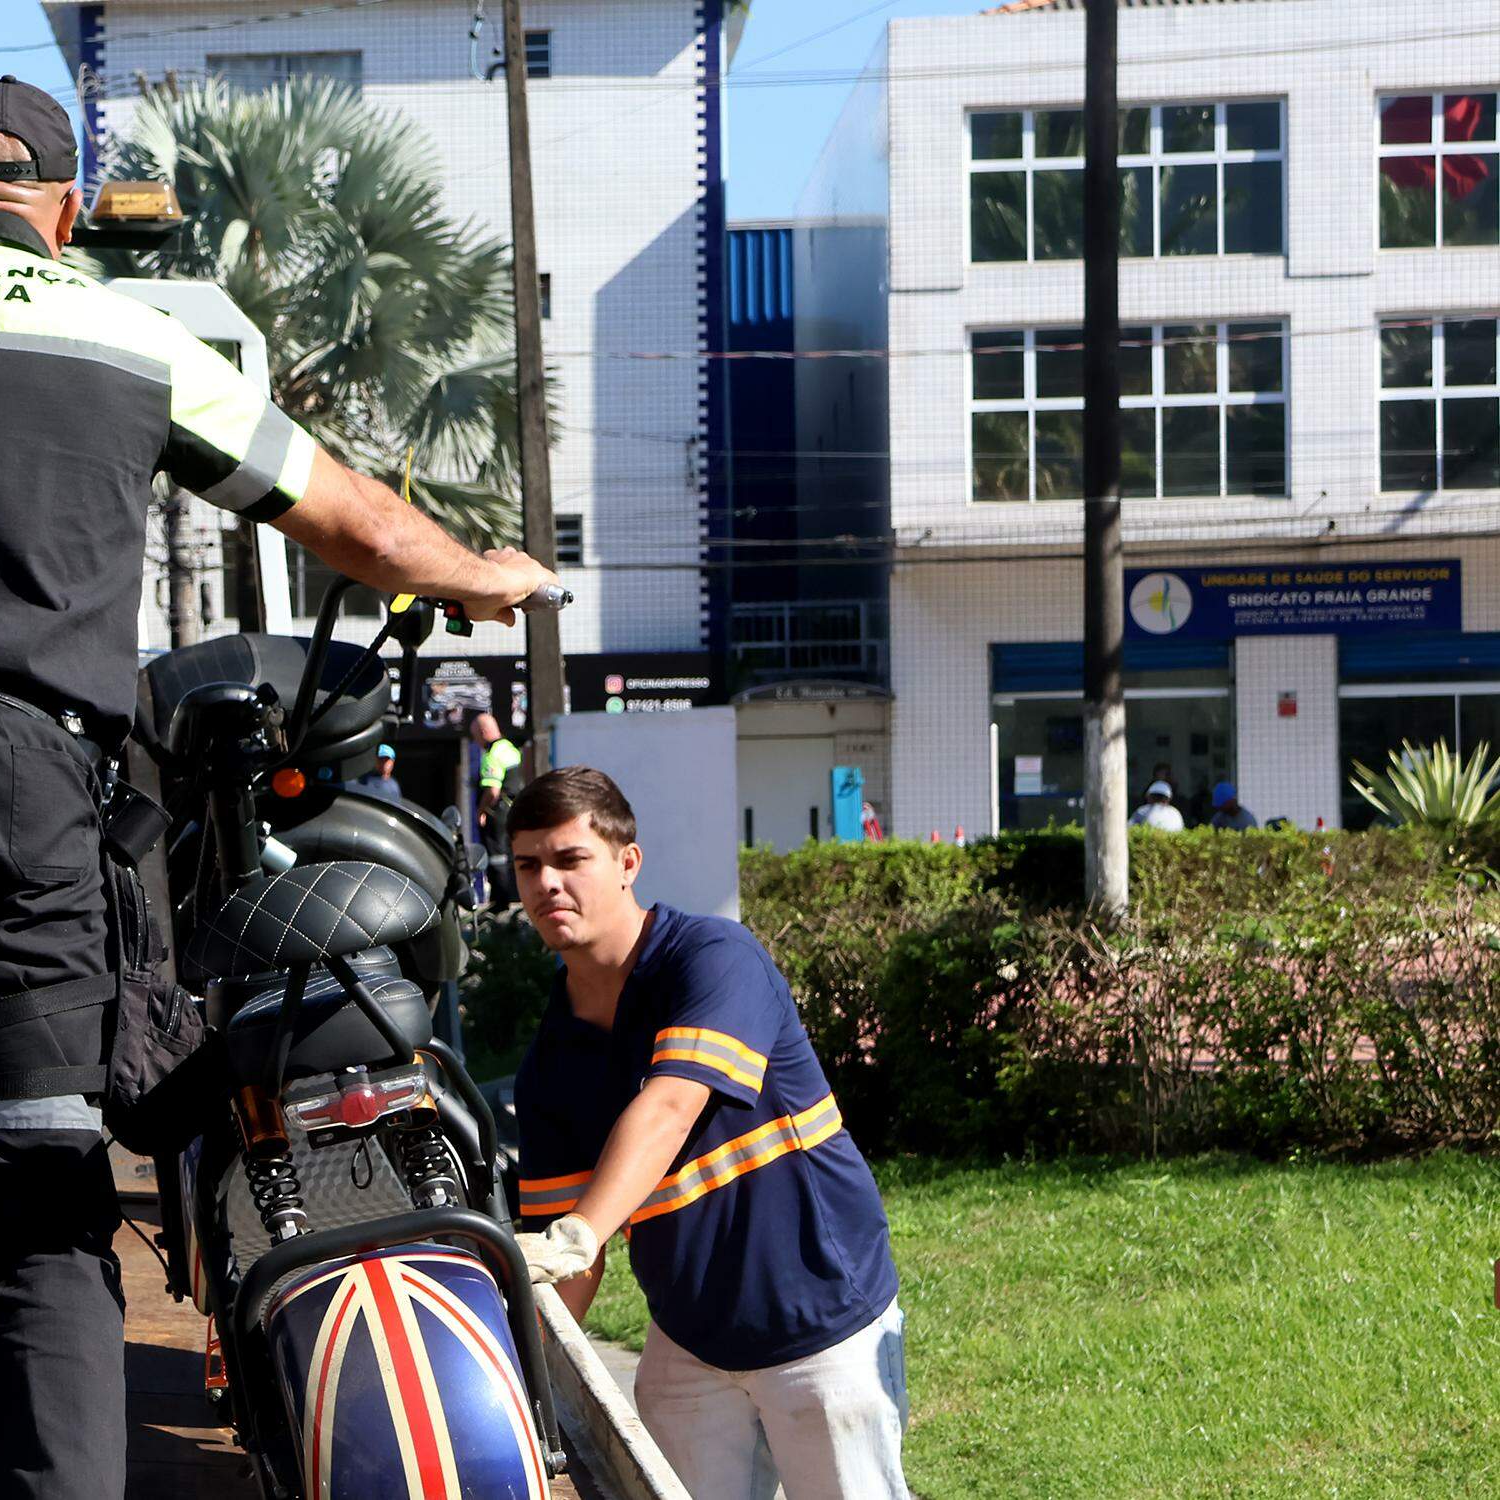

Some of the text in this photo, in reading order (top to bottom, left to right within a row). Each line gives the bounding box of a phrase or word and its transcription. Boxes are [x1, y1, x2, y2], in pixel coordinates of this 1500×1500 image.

[1202, 573, 1267, 587] UNIDADE
[1271, 572, 1291, 585] DE
[1348, 569, 1370, 583] DO
[1375, 567, 1450, 582] SERVIDOR
[1228, 587, 1432, 607] SINDICATO PRAIA GRANDE
